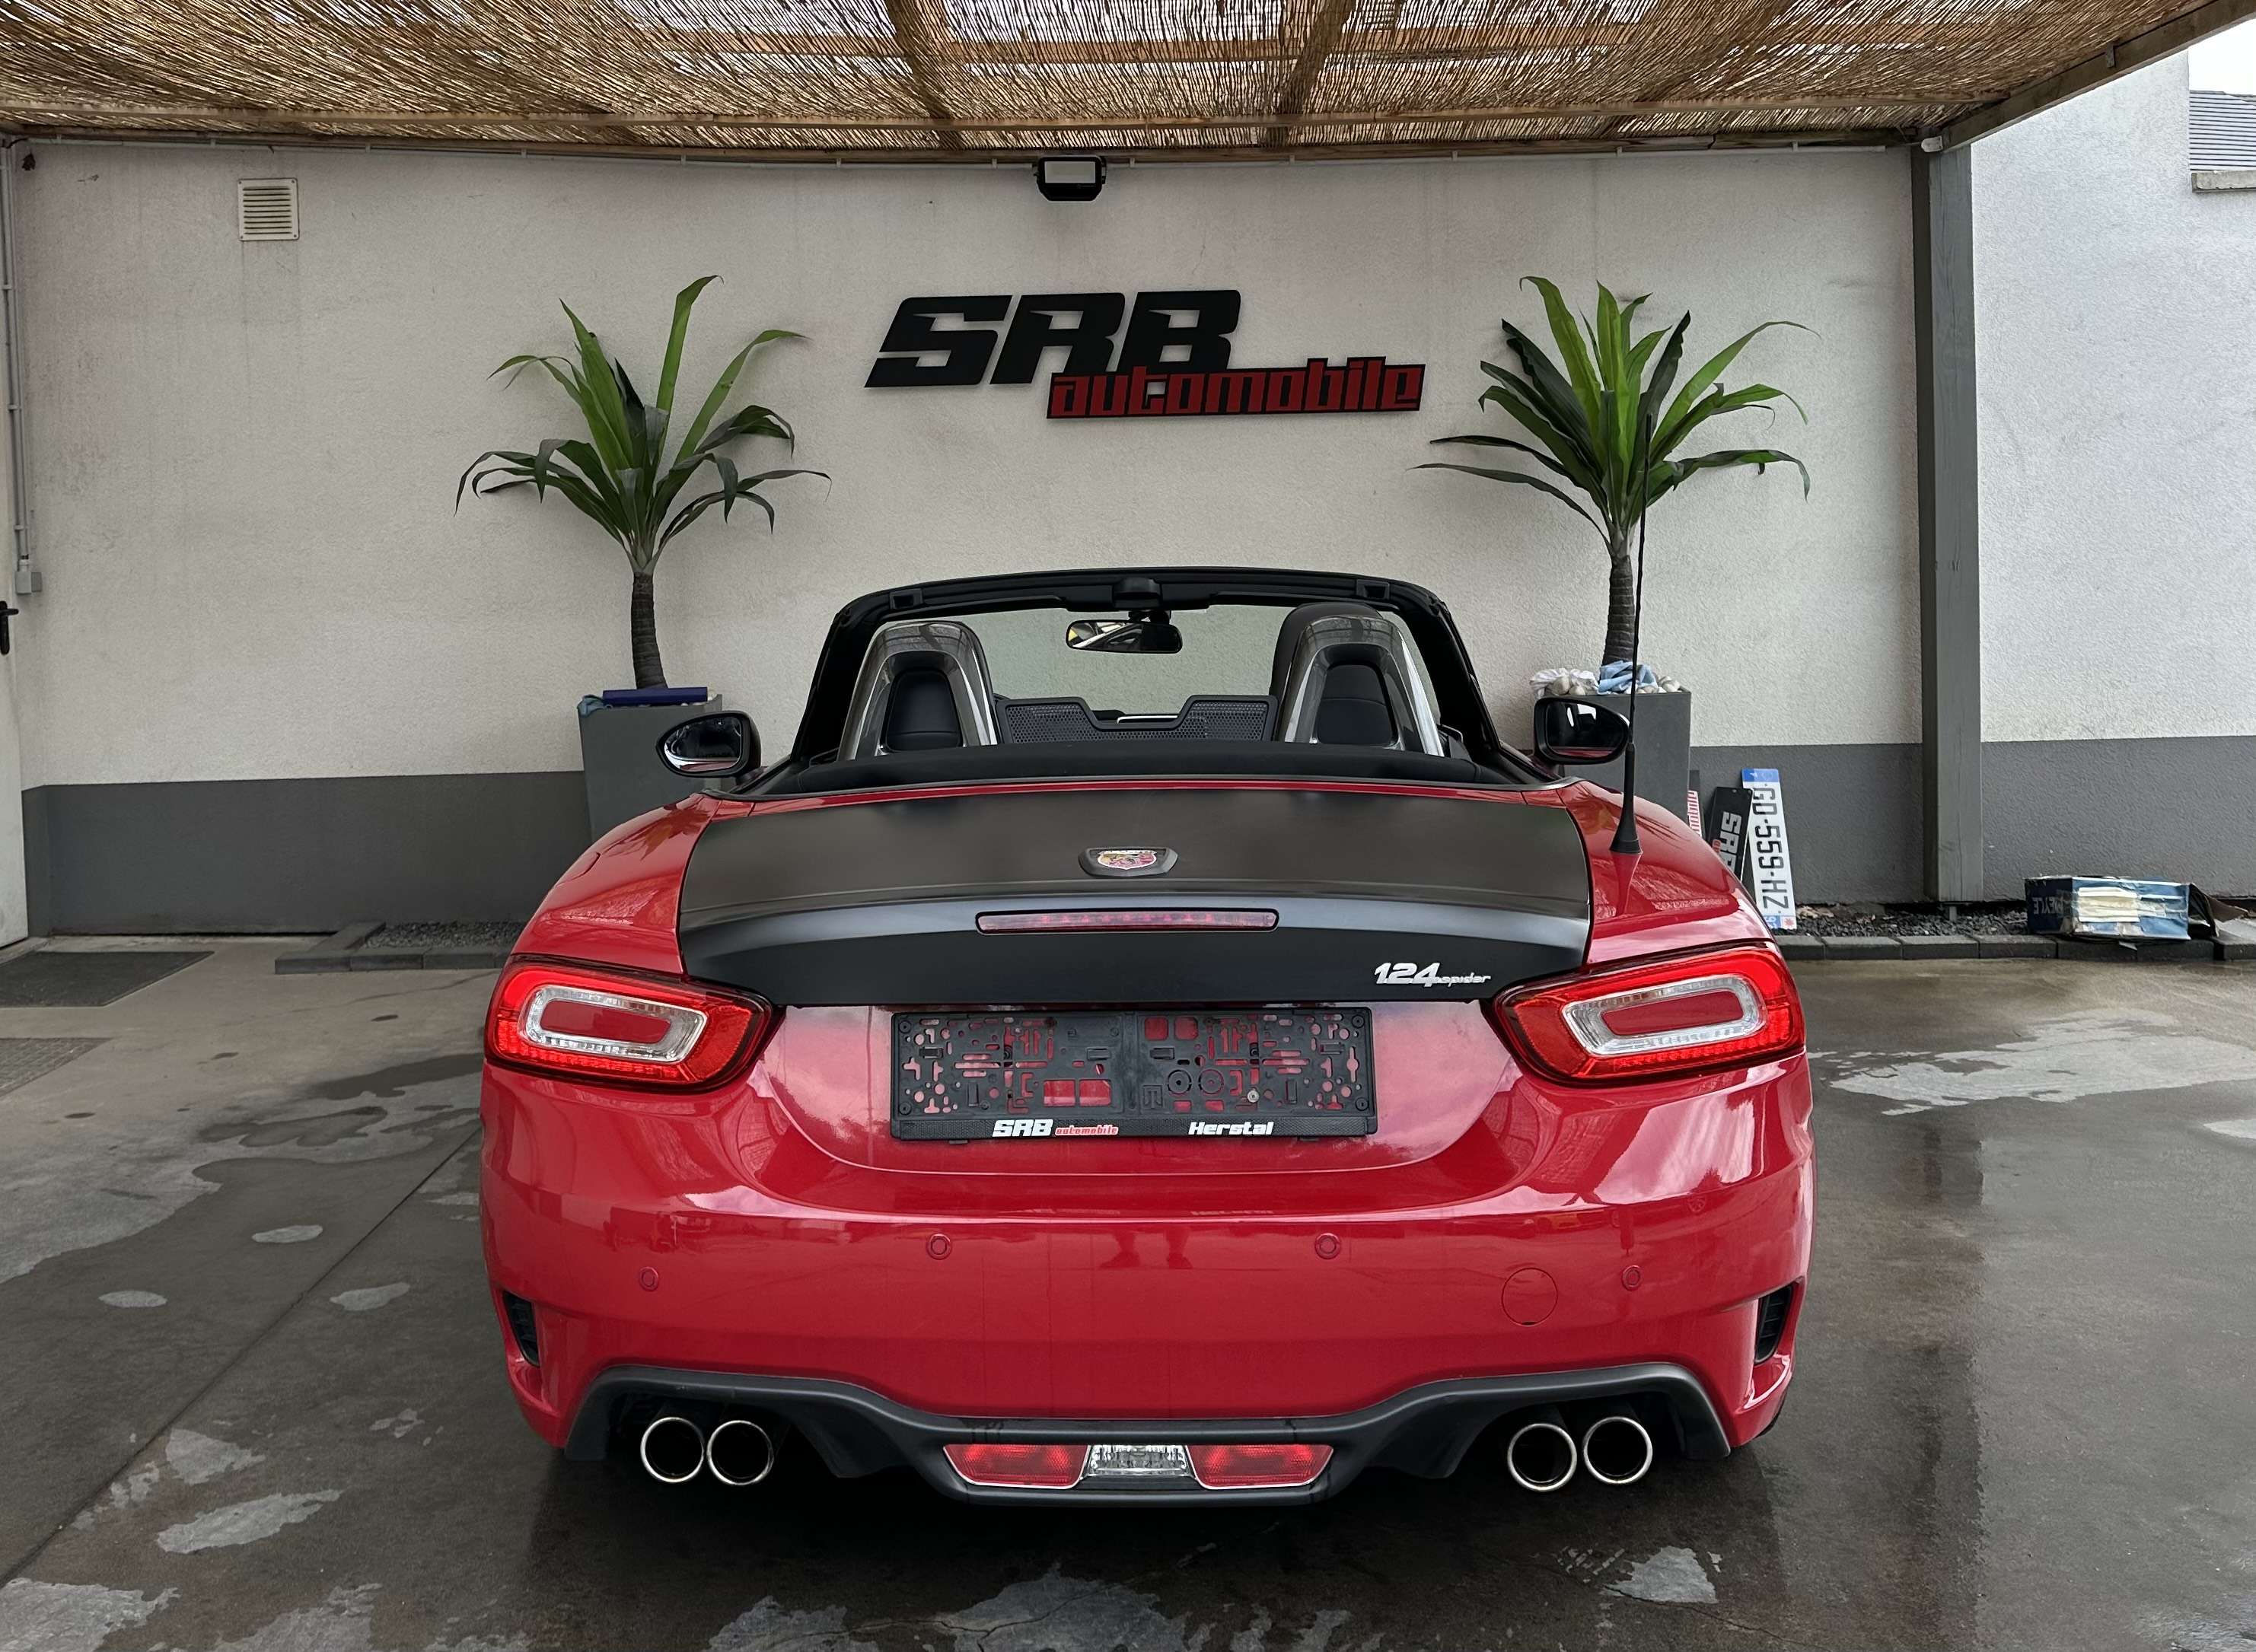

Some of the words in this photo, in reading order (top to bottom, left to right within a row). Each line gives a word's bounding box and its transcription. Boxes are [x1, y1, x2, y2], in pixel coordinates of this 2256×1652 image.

[865, 289, 1241, 388] SRB
[1047, 356, 1426, 419] automobile
[1752, 787, 1789, 909] GD-559-HZ
[1374, 963, 1440, 987] 124
[1439, 972, 1491, 987] spider
[993, 1119, 1053, 1137] SRB
[1054, 1124, 1120, 1136] automobile
[1187, 1121, 1274, 1136] Herstal
